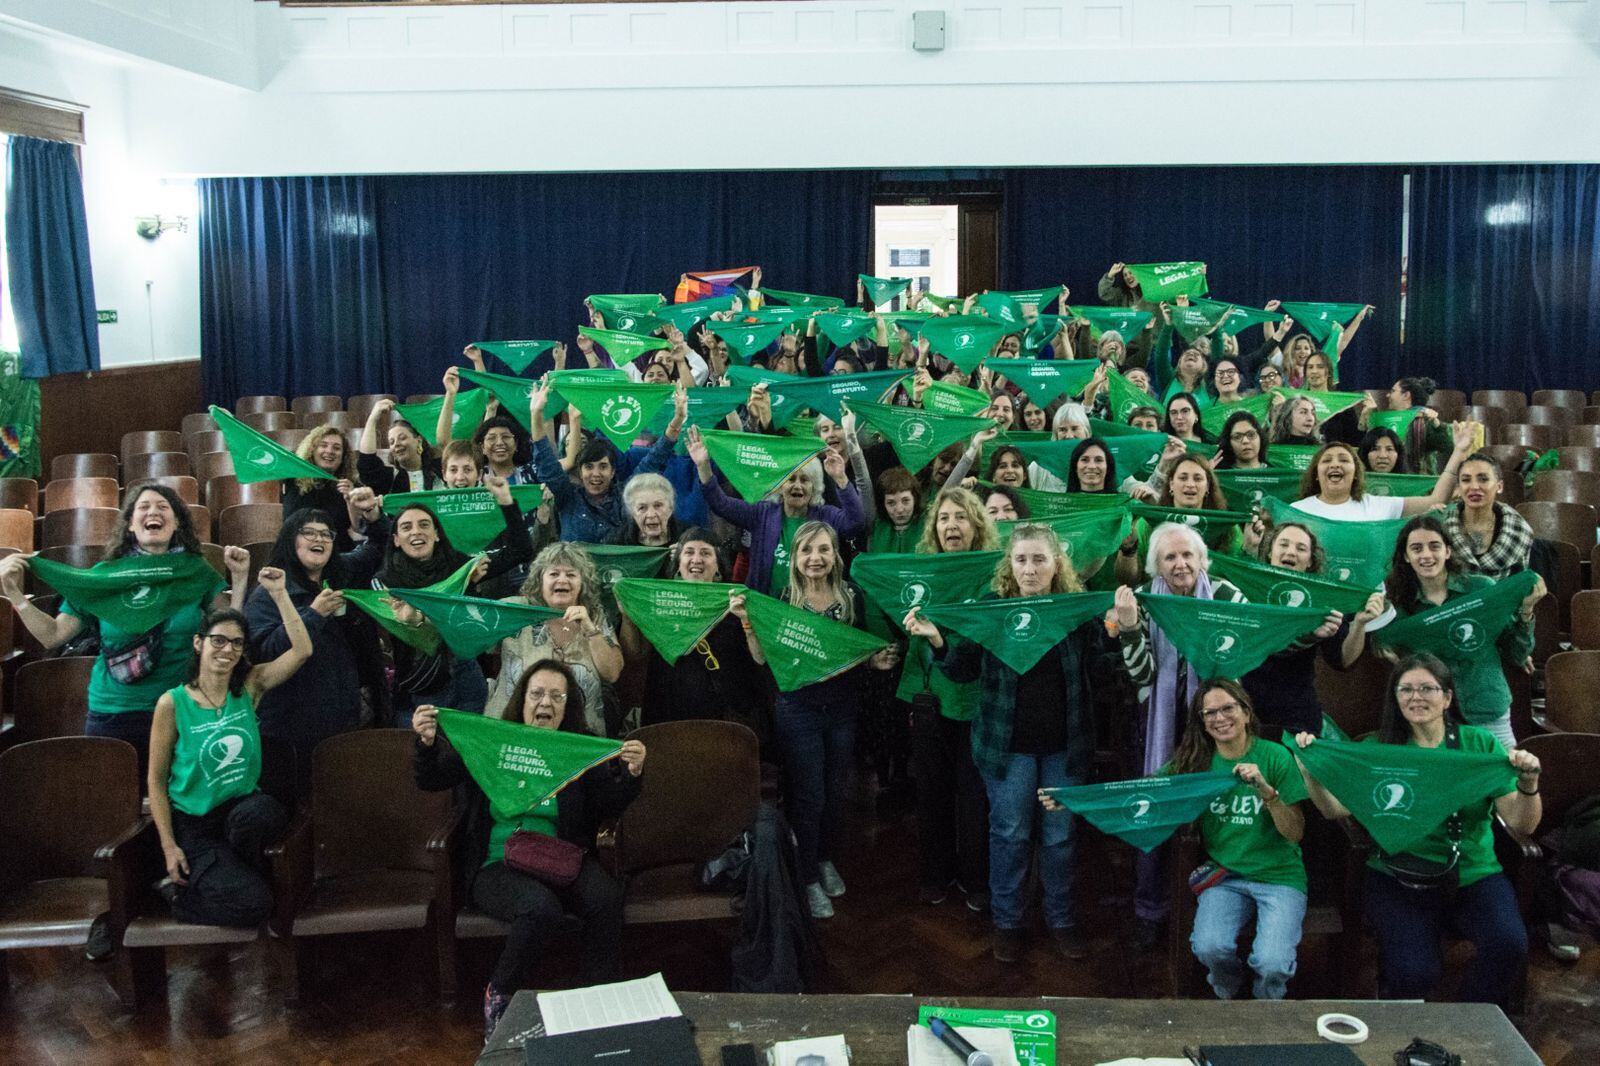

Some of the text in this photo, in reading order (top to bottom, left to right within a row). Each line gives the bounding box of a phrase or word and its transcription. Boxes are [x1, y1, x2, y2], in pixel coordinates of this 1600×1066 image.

[1159, 271, 1190, 286] LEGAL
[831, 381, 861, 389] SEGURO,
[831, 386, 869, 395] GRATUITO.
[741, 444, 769, 455] LEGAL,
[740, 451, 774, 463] SEGURO,
[740, 458, 779, 469] GRATUITO.
[774, 543, 789, 558] Es
[655, 590, 688, 600] LEGAL,
[655, 599, 697, 610] SEGURO,
[786, 619, 818, 639] LEGAL,
[784, 628, 823, 649] SEGURO,
[780, 636, 828, 660] GRATUITO.
[507, 745, 542, 758] LEGAL,
[504, 753, 548, 768] SEGURO,
[503, 761, 554, 777] GRATUITO.
[1231, 794, 1264, 815] LEY
